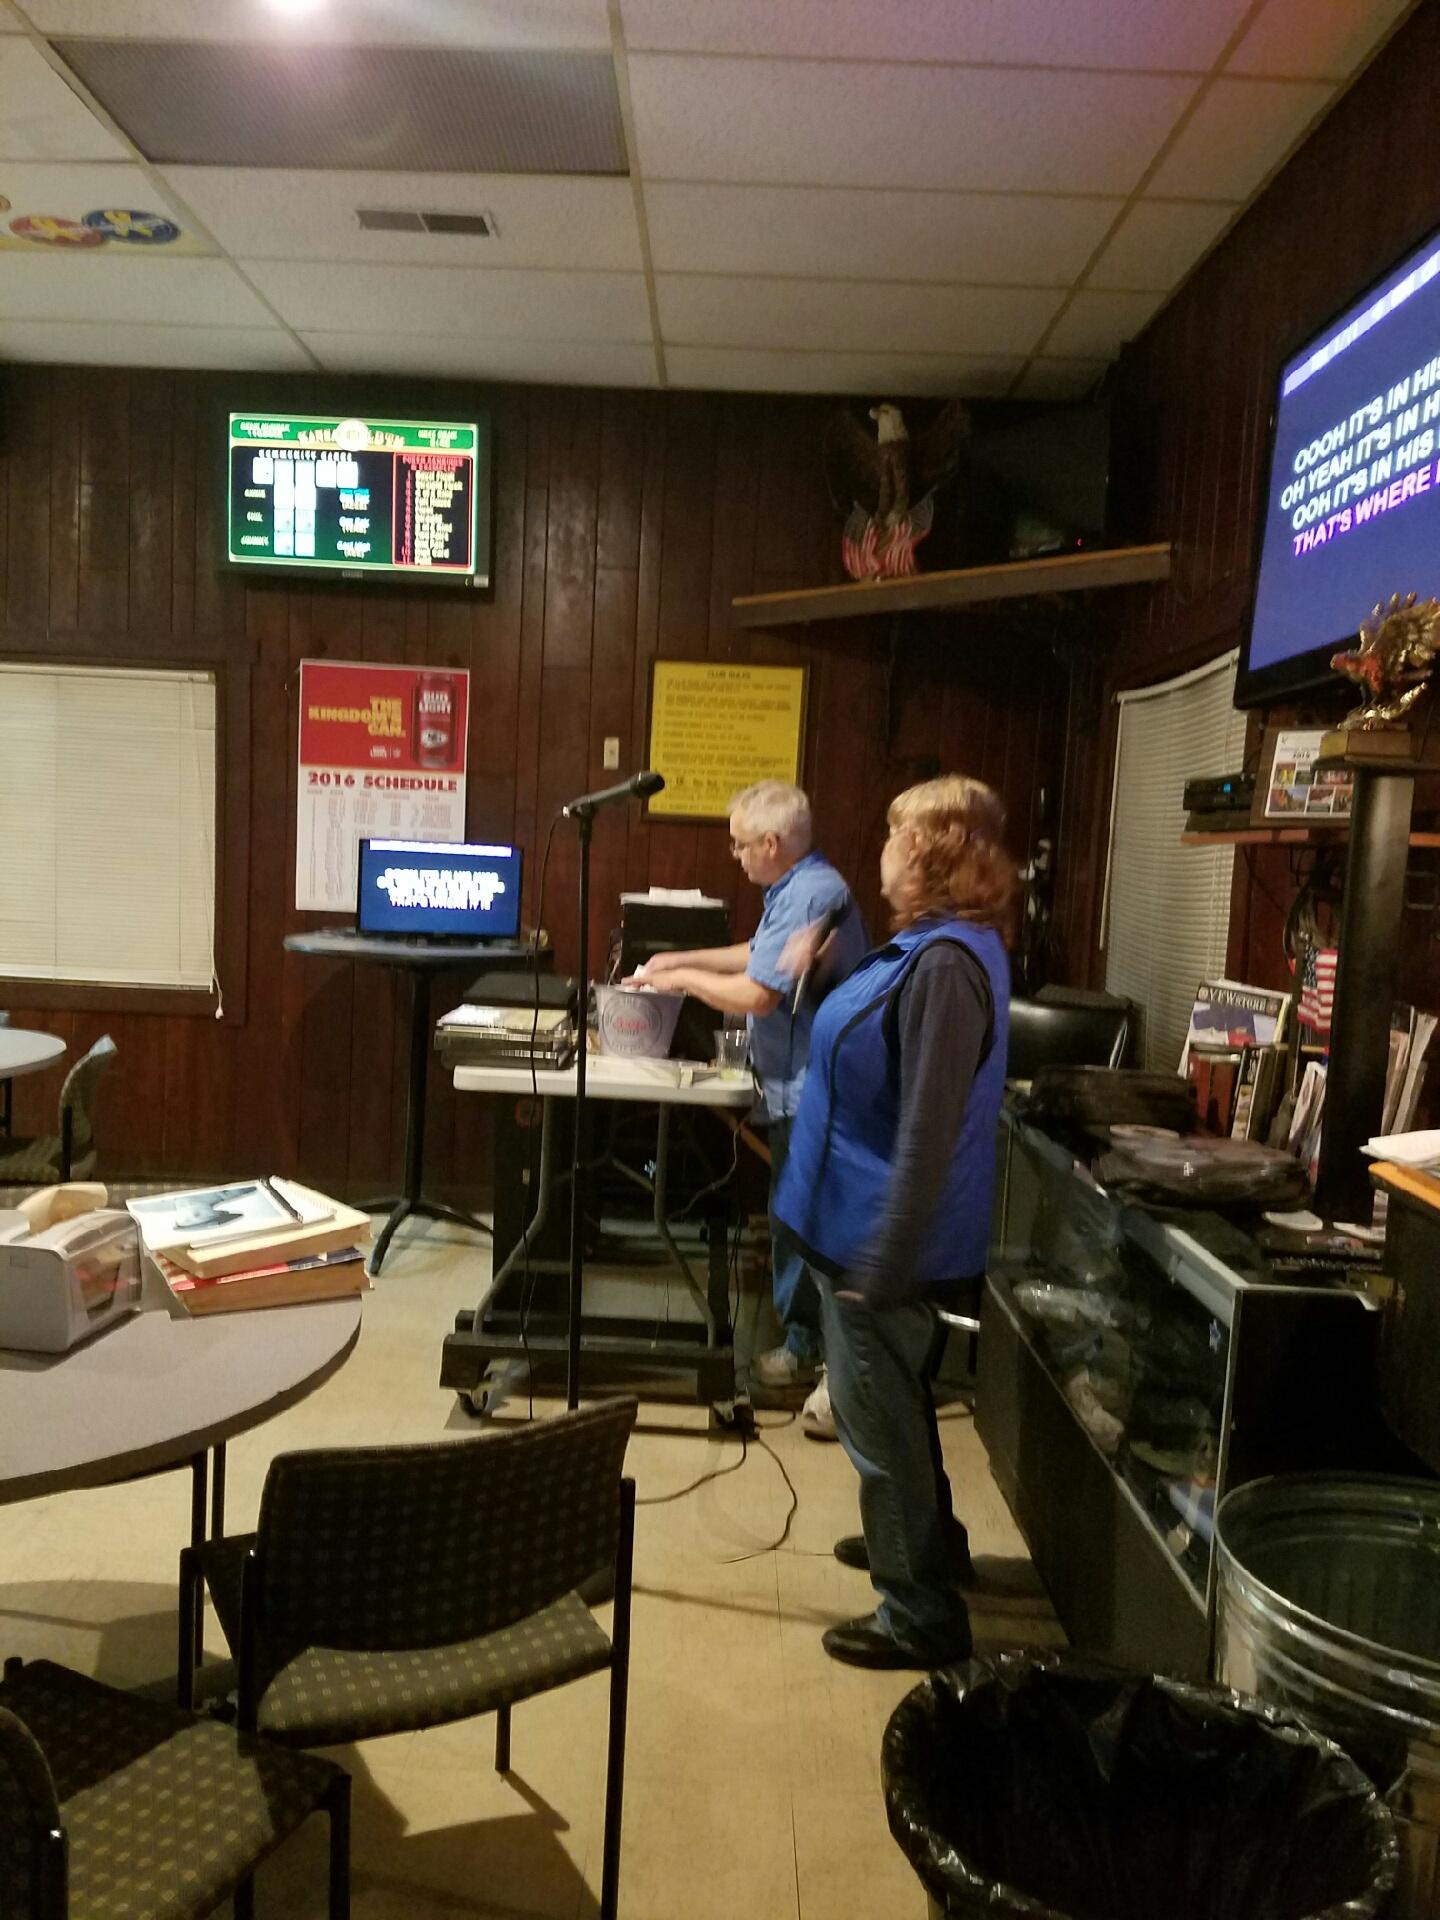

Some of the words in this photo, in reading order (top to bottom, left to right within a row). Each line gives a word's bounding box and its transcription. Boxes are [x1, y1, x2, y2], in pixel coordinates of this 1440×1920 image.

[1281, 476, 1306, 510] OH
[1308, 445, 1353, 493] YEAH
[1356, 421, 1392, 466] IT'S
[1395, 403, 1419, 441] IN
[1294, 420, 1346, 474] OOOH
[1348, 395, 1384, 440] IT'S
[1386, 376, 1410, 415] IN
[1292, 489, 1331, 531] OOH
[1334, 467, 1368, 508] IT'S
[1370, 450, 1393, 487] IN
[1396, 428, 1434, 472] HIS
[1293, 508, 1352, 556] THAT'S
[1355, 464, 1431, 525] WHERE
[419, 701, 451, 715] LIGHT
[423, 689, 449, 704] BUD
[308, 771, 355, 787] 2016
[363, 775, 457, 793] SCHEDULE
